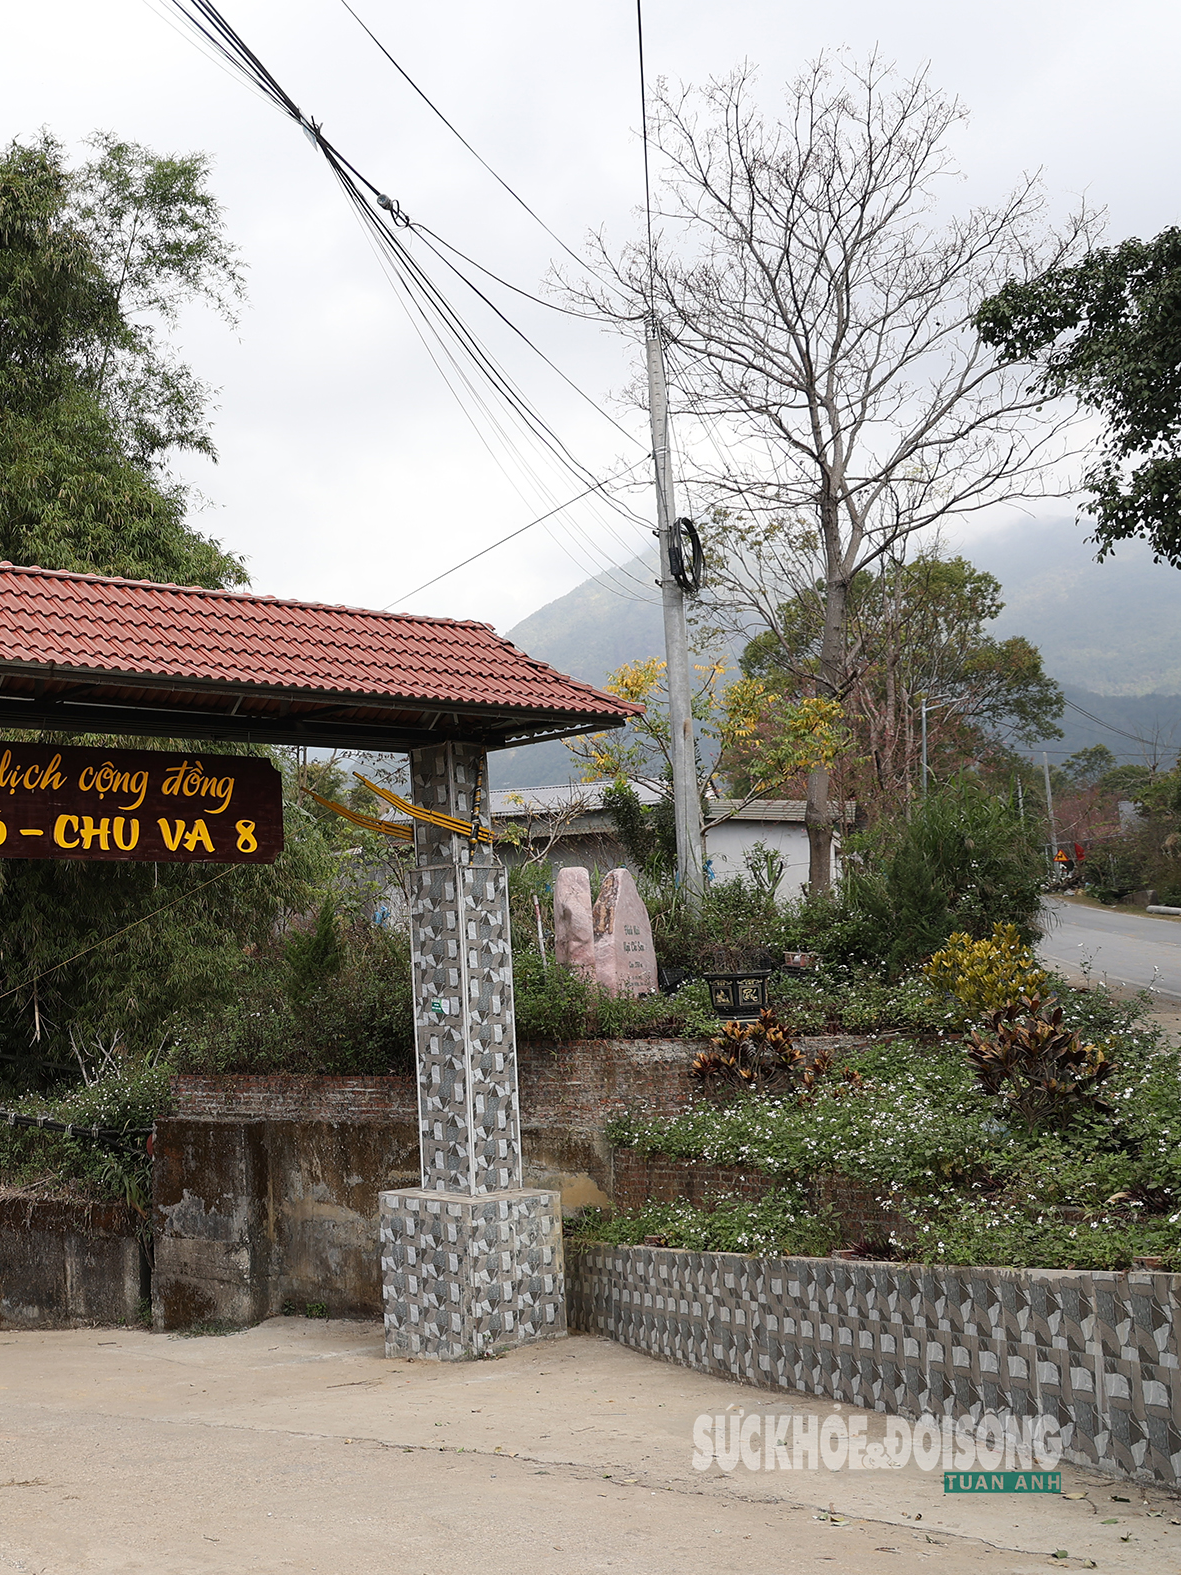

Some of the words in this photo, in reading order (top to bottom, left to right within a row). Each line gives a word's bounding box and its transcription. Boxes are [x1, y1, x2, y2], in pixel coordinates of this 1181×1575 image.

[78, 761, 149, 810] cộng
[161, 760, 235, 815] đồng
[53, 814, 140, 851] CHU
[157, 817, 215, 853] VA
[235, 819, 258, 853] 8
